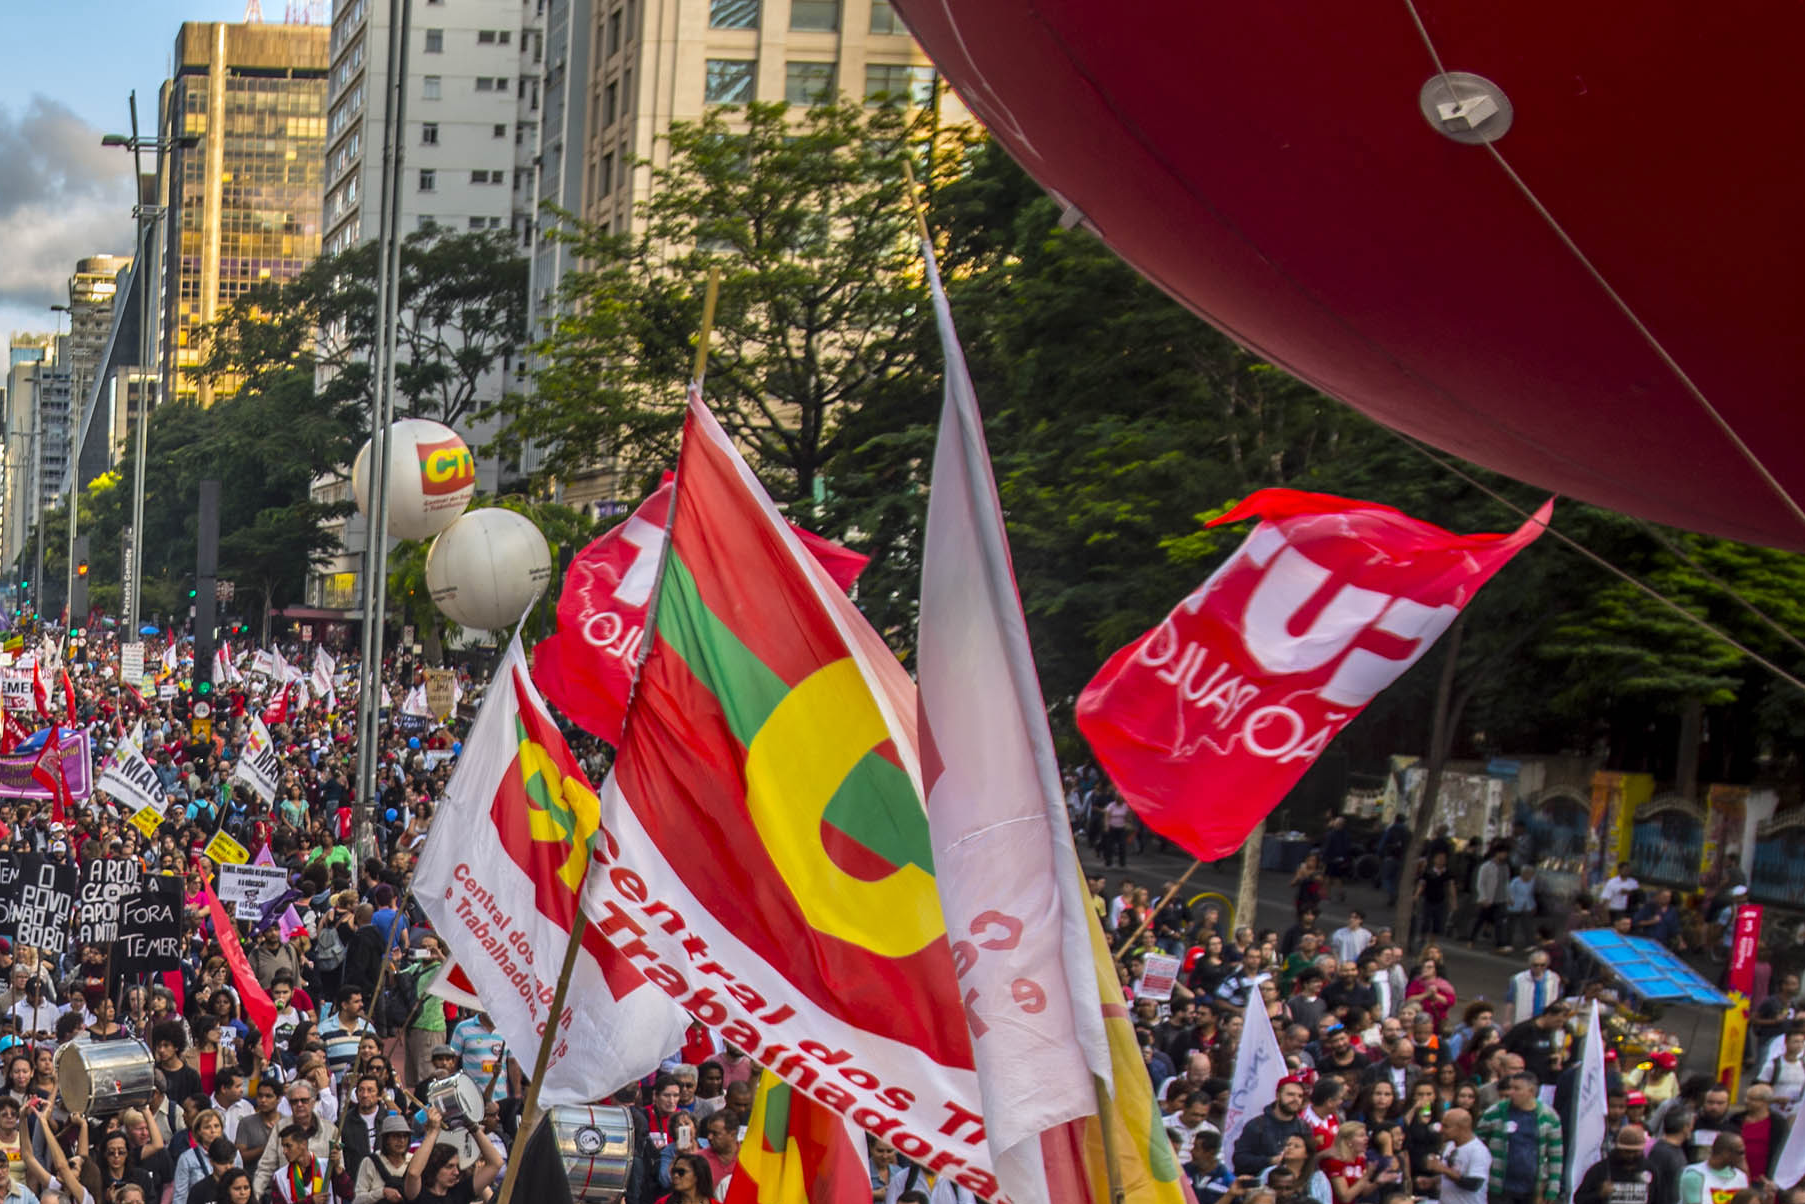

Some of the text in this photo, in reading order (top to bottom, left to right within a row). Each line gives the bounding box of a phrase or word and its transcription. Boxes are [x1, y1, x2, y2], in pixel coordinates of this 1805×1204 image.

[426, 448, 475, 482] CT
[123, 582, 132, 615] Peixoto
[121, 754, 166, 803] MAIS
[39, 863, 55, 889] O
[90, 859, 142, 885] A REDE
[22, 884, 72, 918] POVO
[444, 886, 453, 901] e
[123, 897, 175, 925] FORA
[453, 863, 534, 966] Central dos
[17, 922, 65, 953] BOBO
[80, 923, 92, 943] A
[120, 933, 179, 958] TEMER
[796, 1037, 917, 1112] dos
